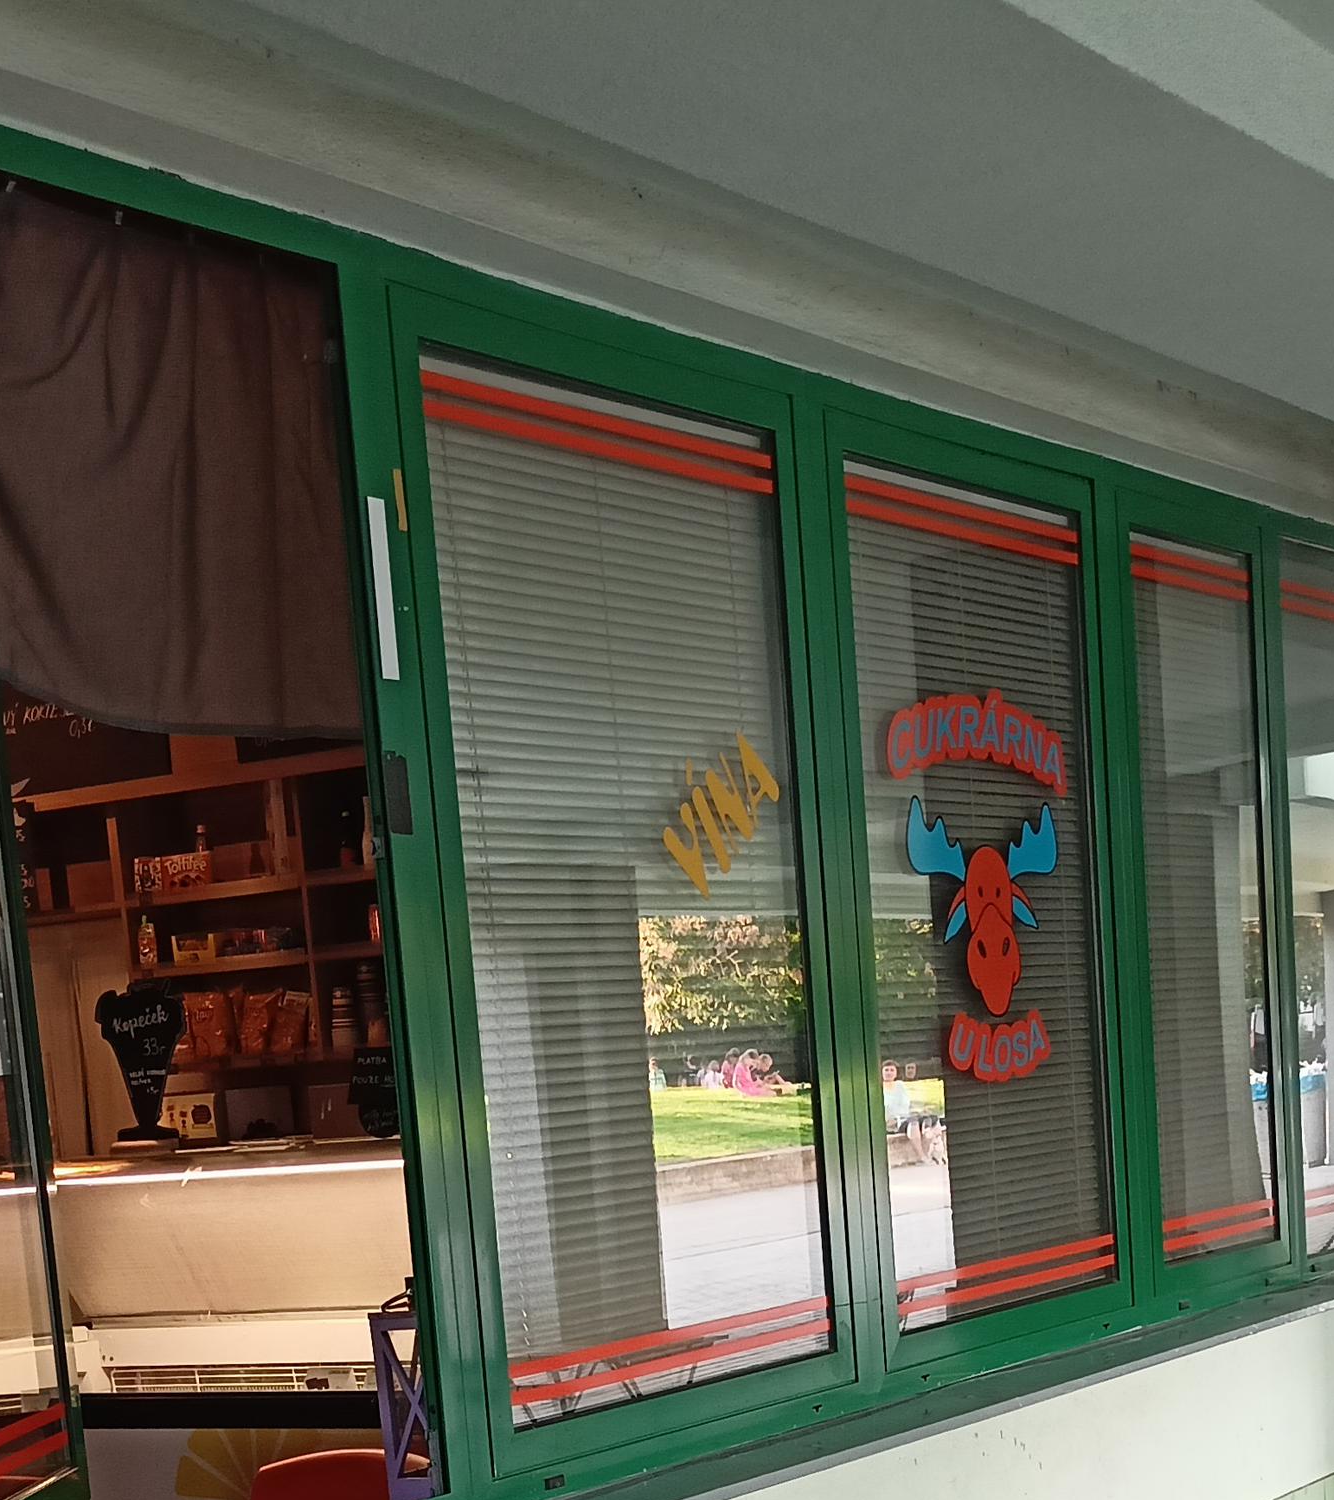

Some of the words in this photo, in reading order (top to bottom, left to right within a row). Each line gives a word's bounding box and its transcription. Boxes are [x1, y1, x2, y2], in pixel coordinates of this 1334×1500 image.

[891, 698, 1062, 786] CUKRÁRNA
[661, 727, 781, 900] VÍNA
[953, 1022, 975, 1063] U
[978, 1018, 1045, 1073] LOSA
